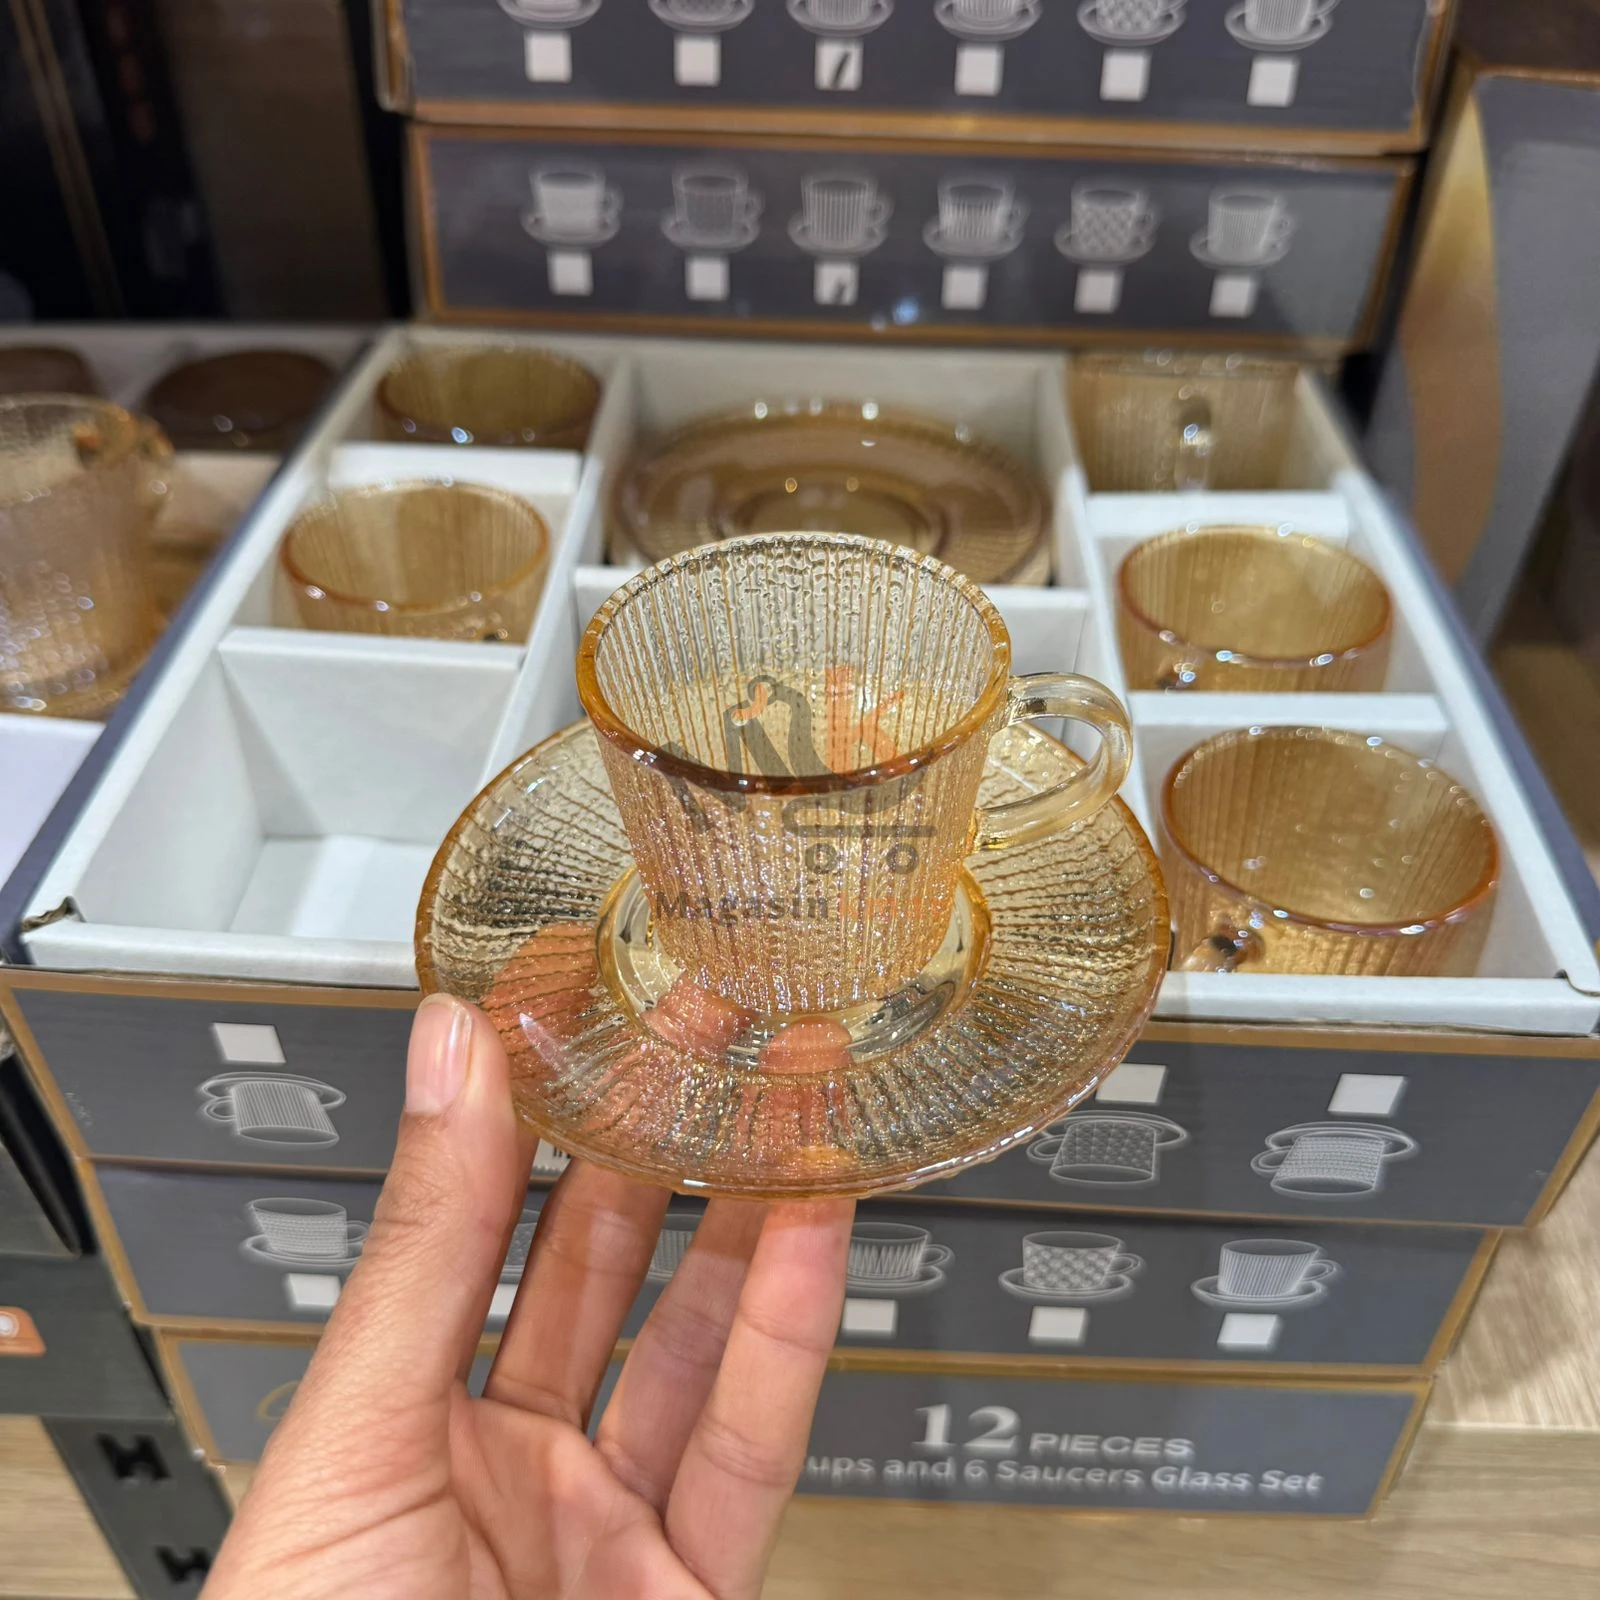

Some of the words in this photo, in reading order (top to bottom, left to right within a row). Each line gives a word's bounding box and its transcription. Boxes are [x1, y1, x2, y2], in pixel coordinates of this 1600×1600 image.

[911, 1402, 1023, 1451] 12
[1028, 1431, 1196, 1458] PIECES
[804, 1455, 877, 1486] ups
[882, 1456, 957, 1482] and
[963, 1458, 989, 1483] 6
[995, 1459, 1146, 1488] Saucers
[1150, 1465, 1254, 1491] Glass
[1258, 1469, 1325, 1496] Set
